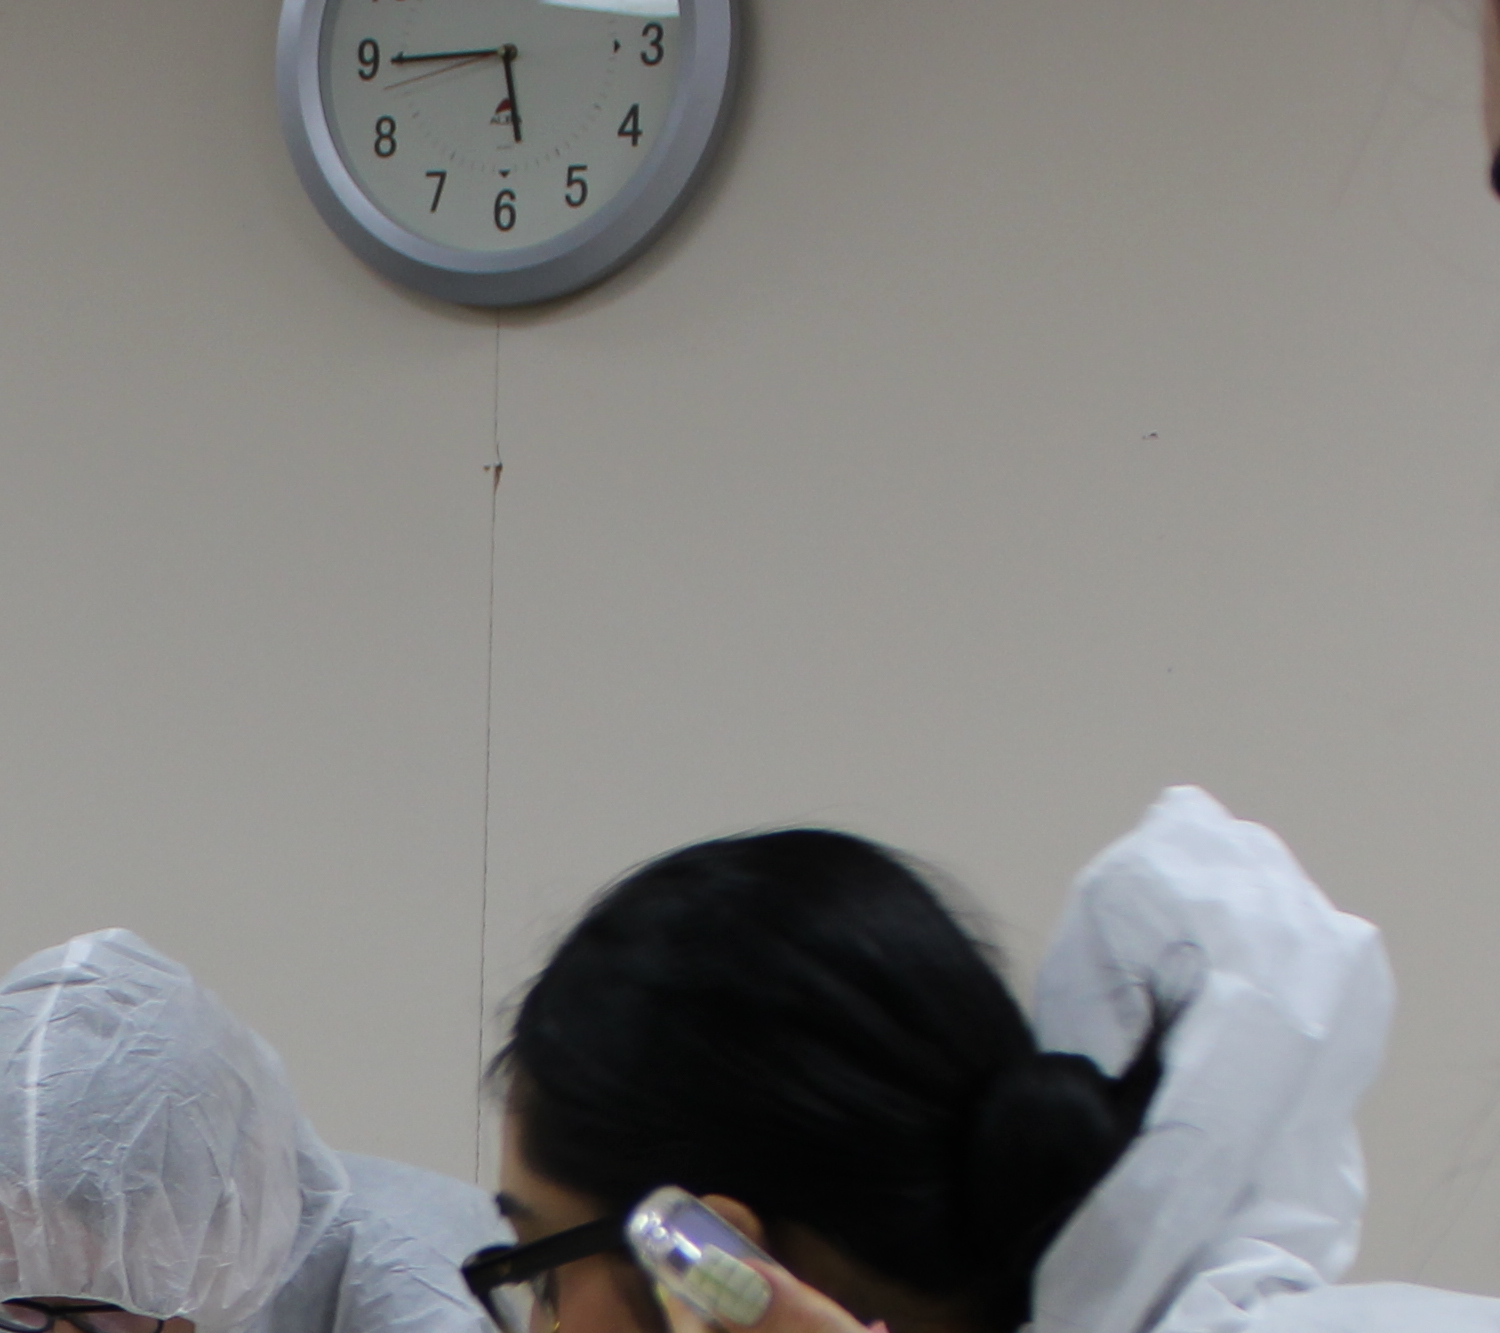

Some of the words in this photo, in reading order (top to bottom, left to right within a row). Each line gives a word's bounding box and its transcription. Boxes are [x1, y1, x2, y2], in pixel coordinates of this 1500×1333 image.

[357, 38, 381, 81] 9
[640, 22, 665, 66] 3
[374, 115, 398, 158] 8
[617, 103, 643, 147] 4
[424, 170, 448, 213] 7
[564, 164, 589, 208] 5
[493, 188, 517, 231] 6
